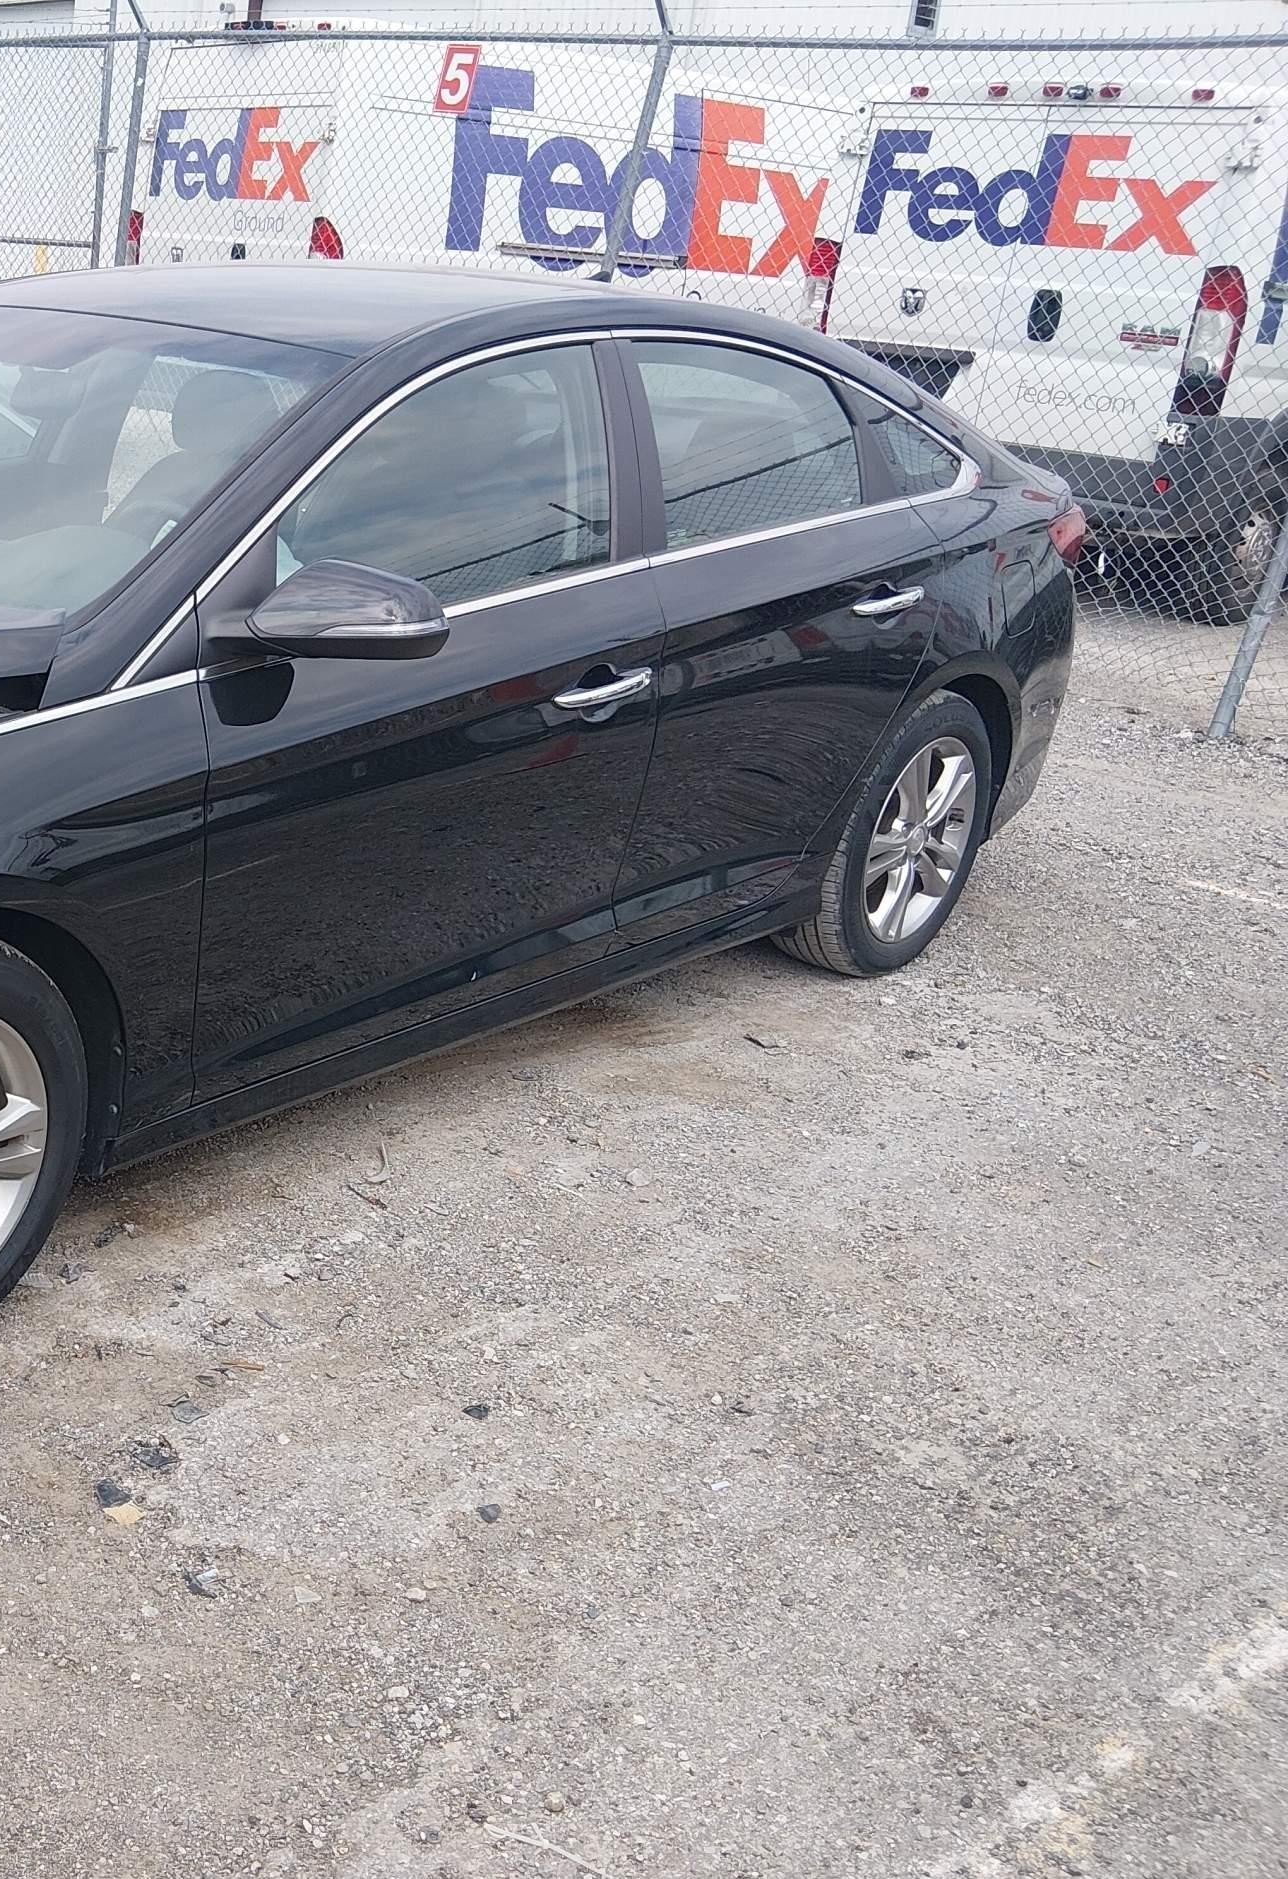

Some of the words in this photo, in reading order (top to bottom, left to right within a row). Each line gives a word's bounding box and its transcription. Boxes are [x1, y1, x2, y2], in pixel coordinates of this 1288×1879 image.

[441, 53, 474, 105] 5
[149, 107, 321, 202] FedEx
[445, 65, 830, 278] FedEx
[233, 209, 284, 233] Ground
[854, 129, 1218, 257] FedEx
[1016, 379, 1136, 414] fedex.com
